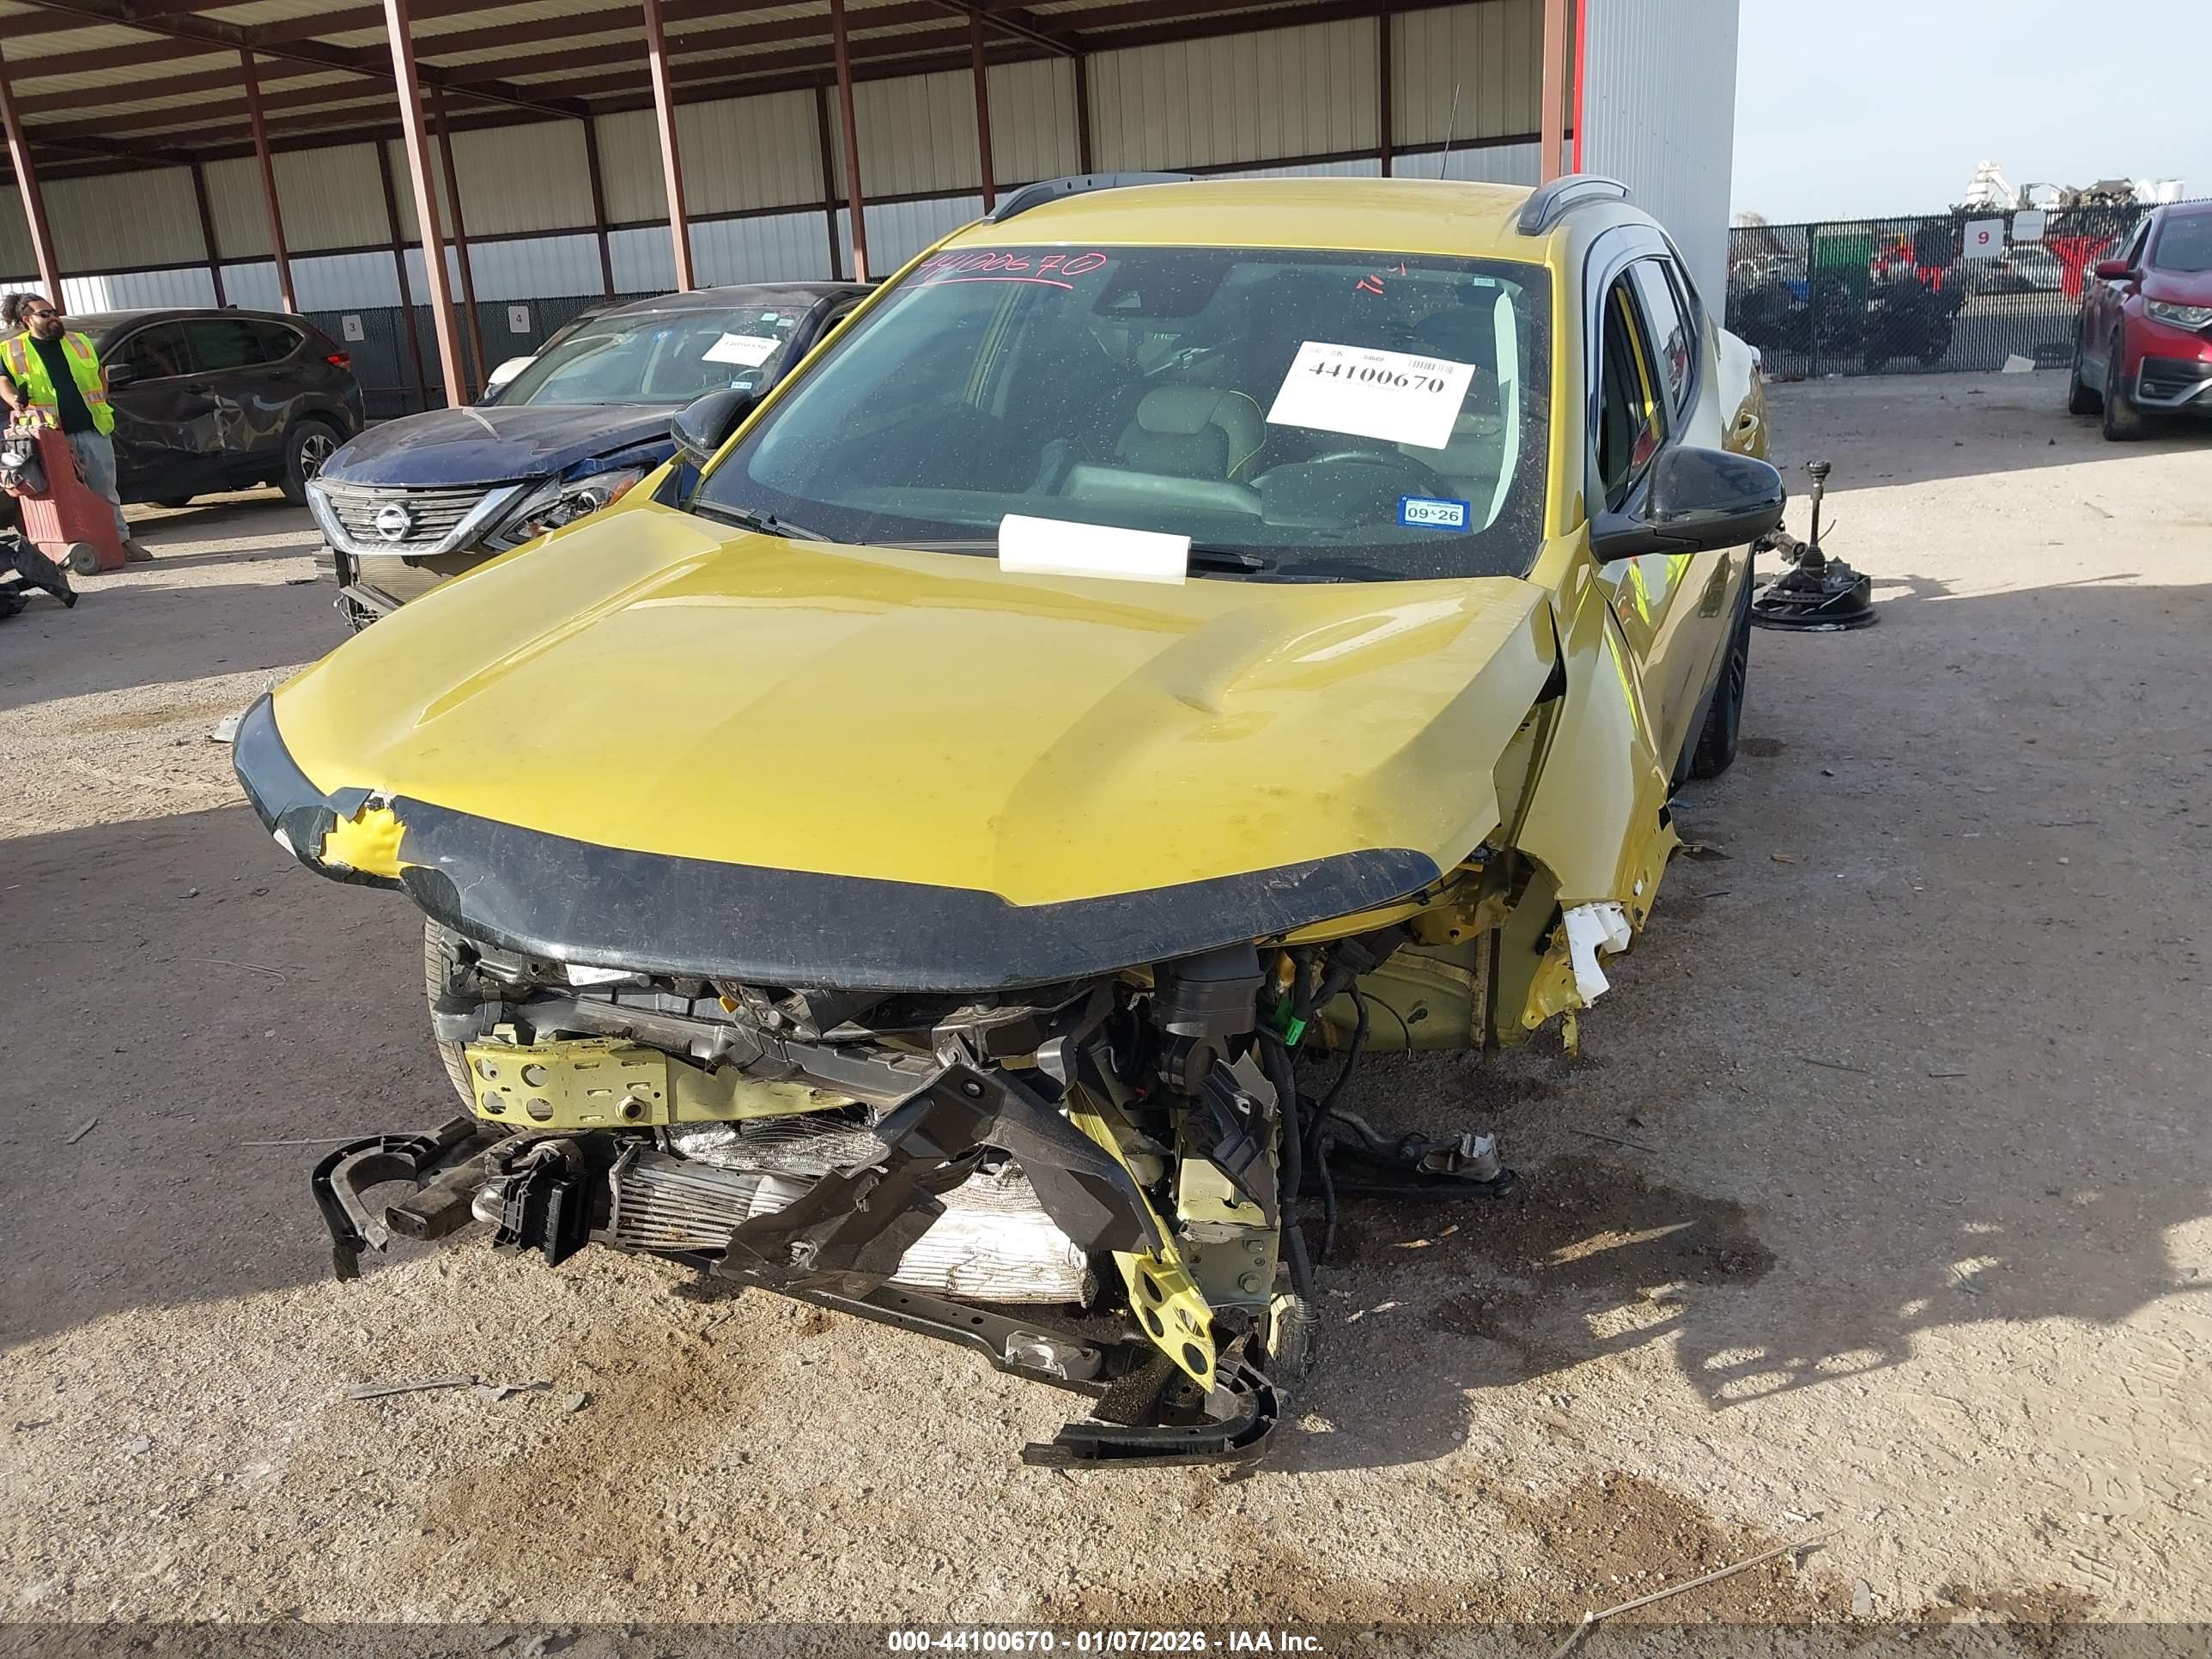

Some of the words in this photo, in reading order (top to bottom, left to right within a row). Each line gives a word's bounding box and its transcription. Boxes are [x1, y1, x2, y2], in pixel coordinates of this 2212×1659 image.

[1978, 231, 1990, 244] 9
[515, 313, 522, 323] 4
[349, 323, 356, 331] 3
[1308, 361, 1445, 393] 44100670
[1407, 507, 1429, 519] 09
[1437, 509, 1459, 521] 26
